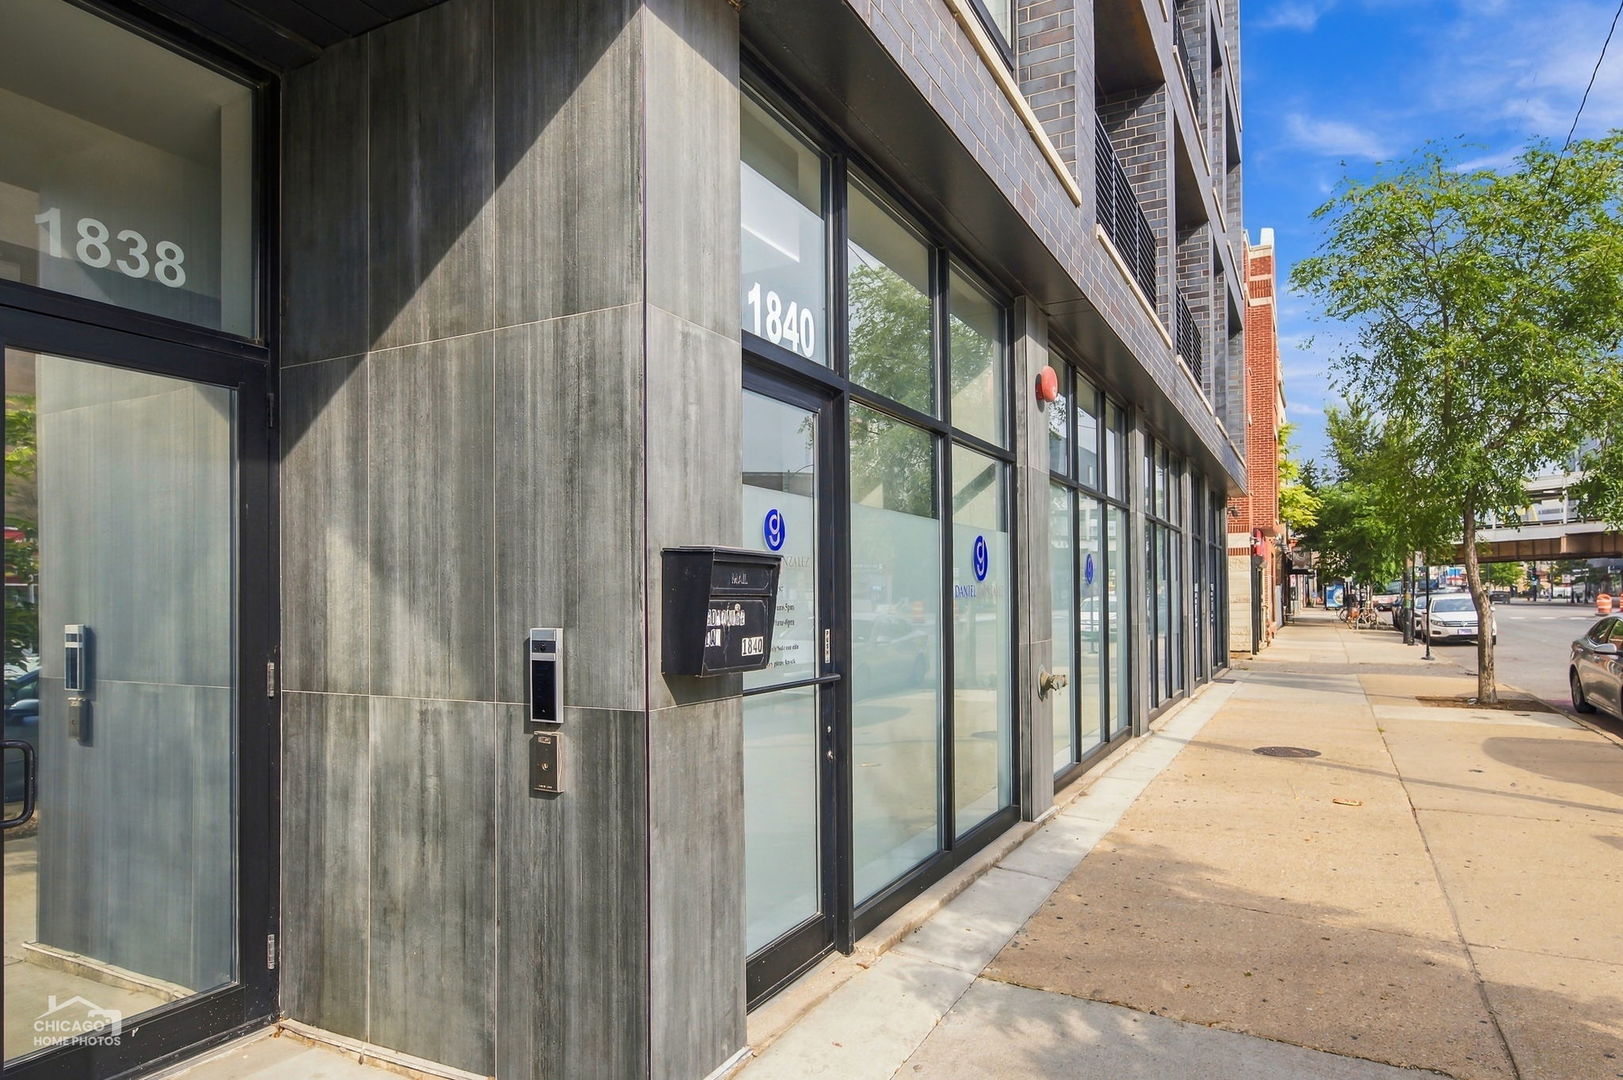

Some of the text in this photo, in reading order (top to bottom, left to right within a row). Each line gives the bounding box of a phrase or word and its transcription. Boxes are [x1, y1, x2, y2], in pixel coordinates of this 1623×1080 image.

[34, 207, 187, 289] 1838
[747, 282, 815, 358] 1840
[954, 584, 976, 598] DANIEL
[742, 637, 763, 655] 1840
